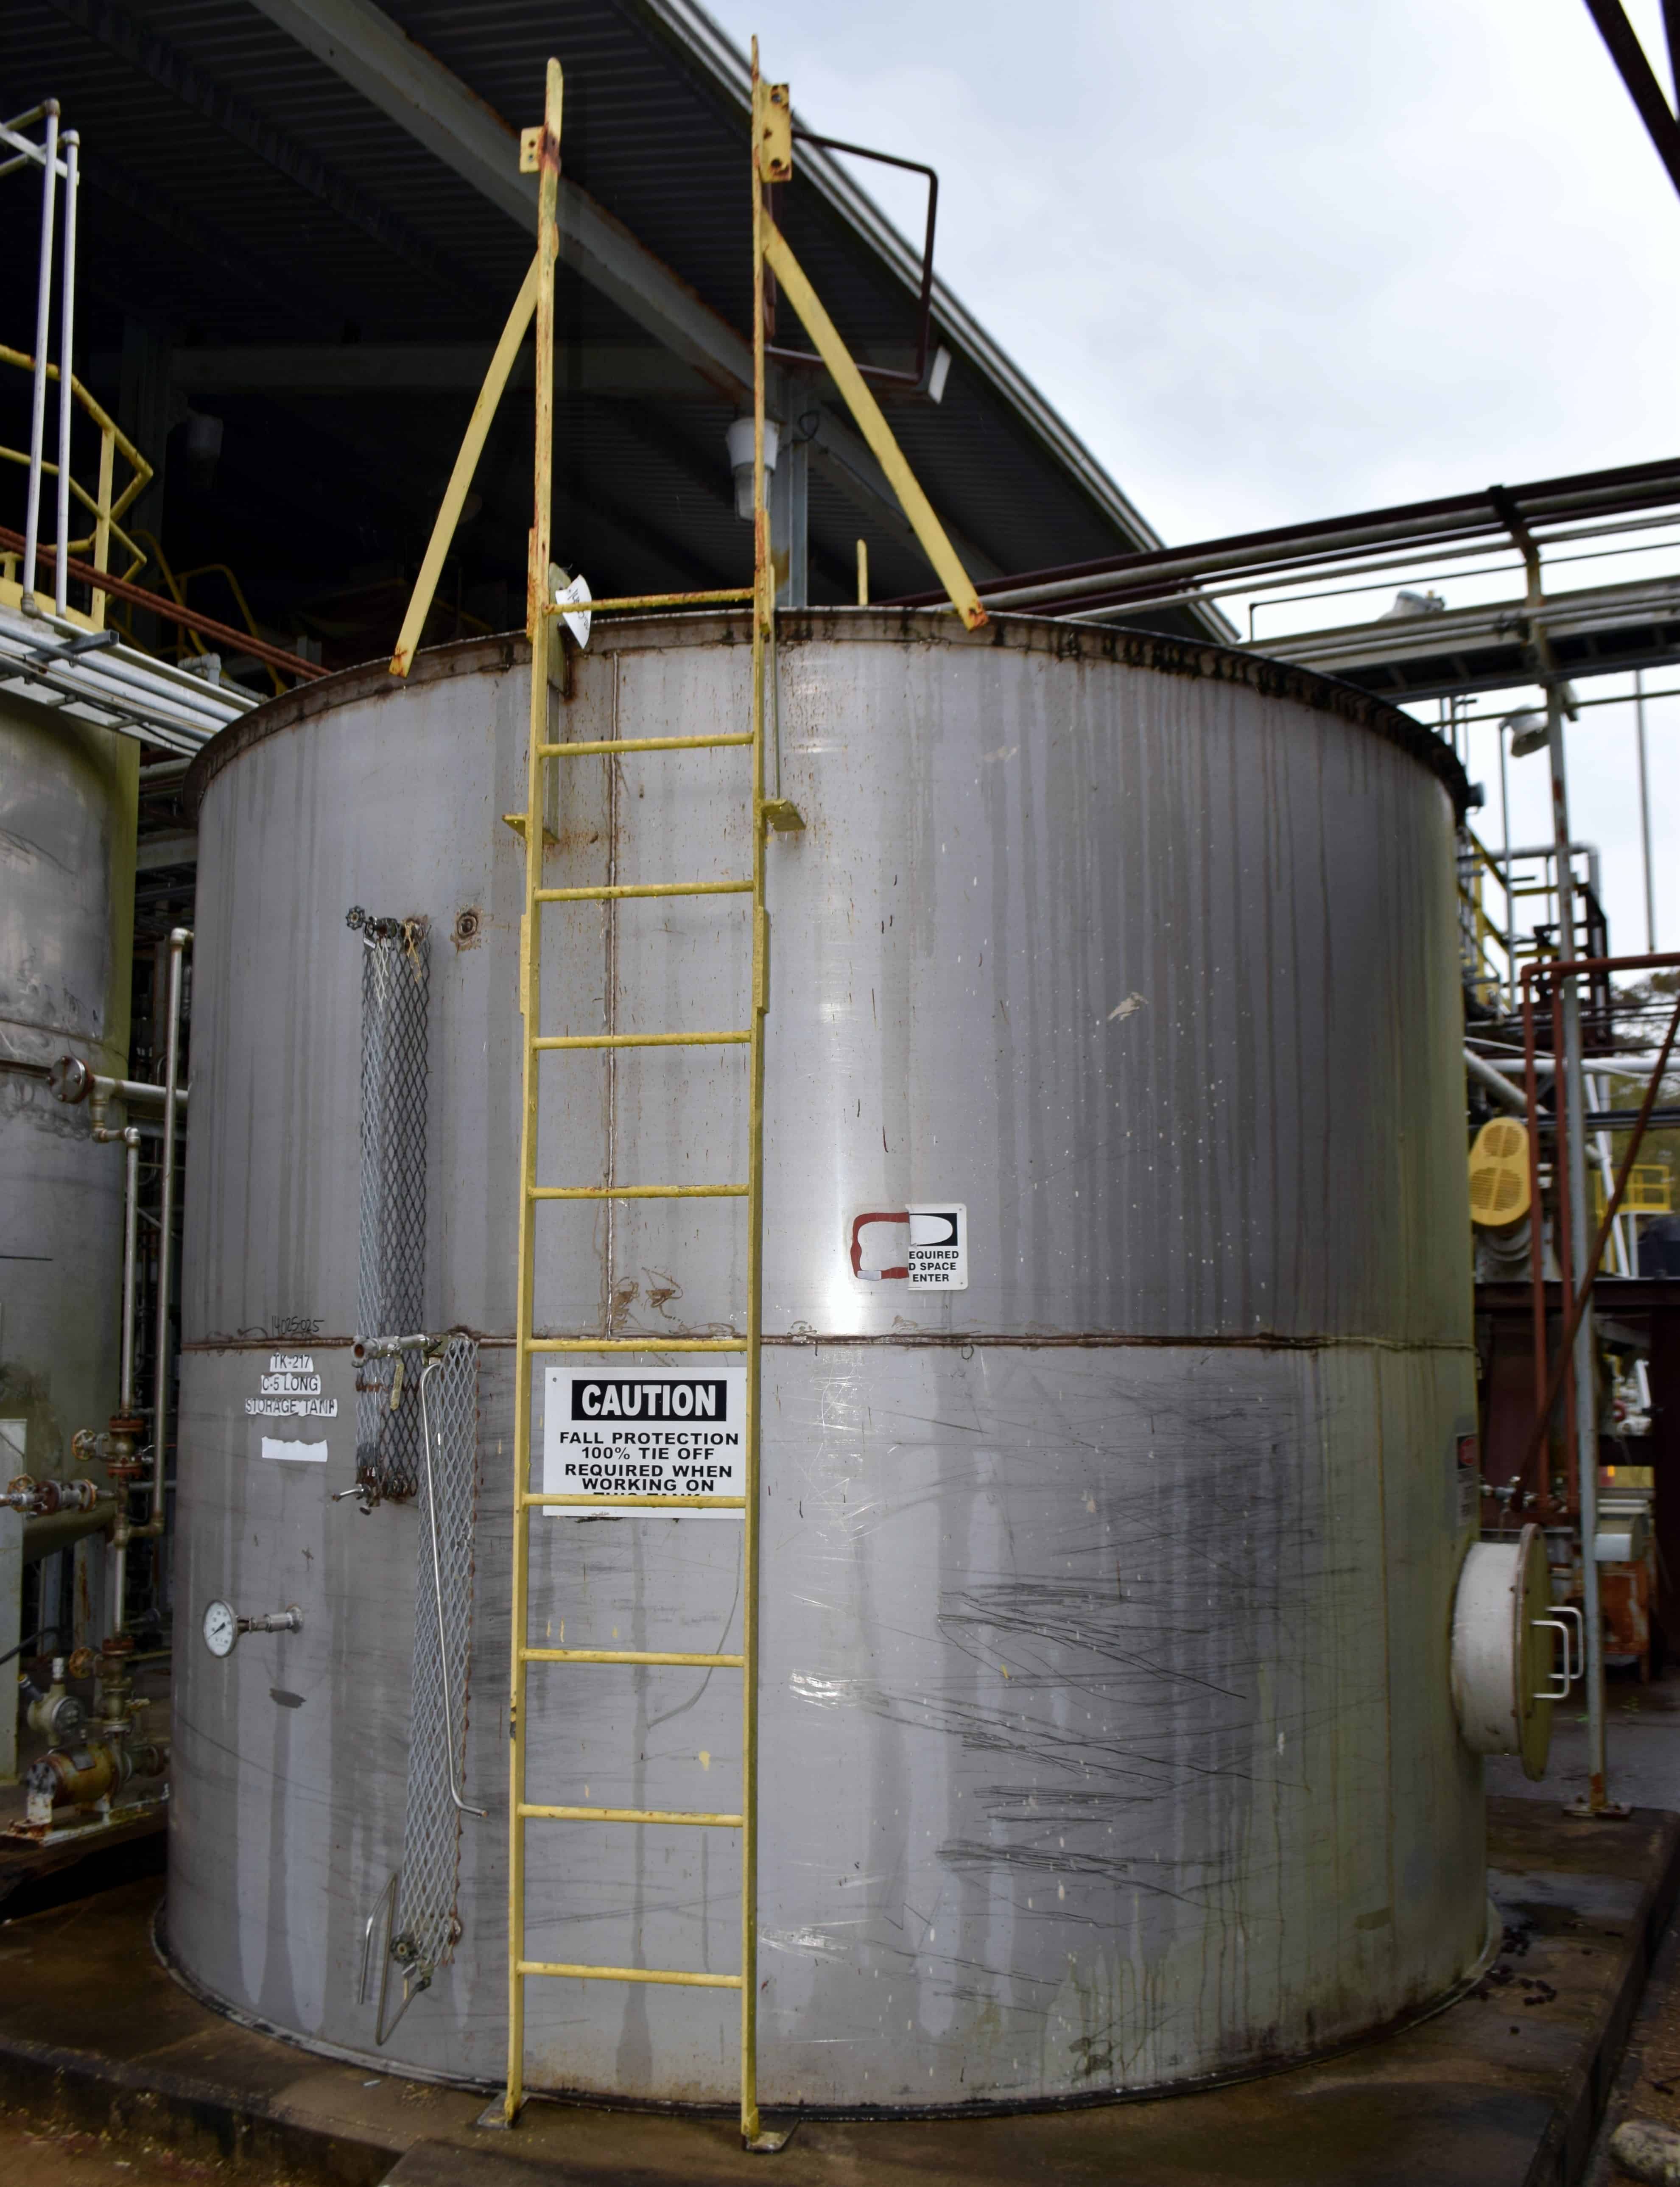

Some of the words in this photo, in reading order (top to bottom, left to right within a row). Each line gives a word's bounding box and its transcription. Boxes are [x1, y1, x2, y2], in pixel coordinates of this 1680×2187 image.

[913, 1274, 949, 1282] ENTER
[274, 1354, 310, 1369] TK-217
[263, 1377, 279, 1391] C-5
[284, 1375, 318, 1391] LONG
[246, 1399, 297, 1413] STORAGE
[582, 1384, 716, 1416] CAUTION
[560, 1432, 604, 1444] FALL
[612, 1433, 738, 1445] PROTECTION
[582, 1447, 630, 1460] 100%
[639, 1448, 669, 1460] TIE
[678, 1448, 714, 1460] OFF
[565, 1464, 662, 1478] REQUIRED
[673, 1465, 732, 1478] WHEN
[582, 1478, 676, 1491] WORKING
[687, 1480, 714, 1492] ON
